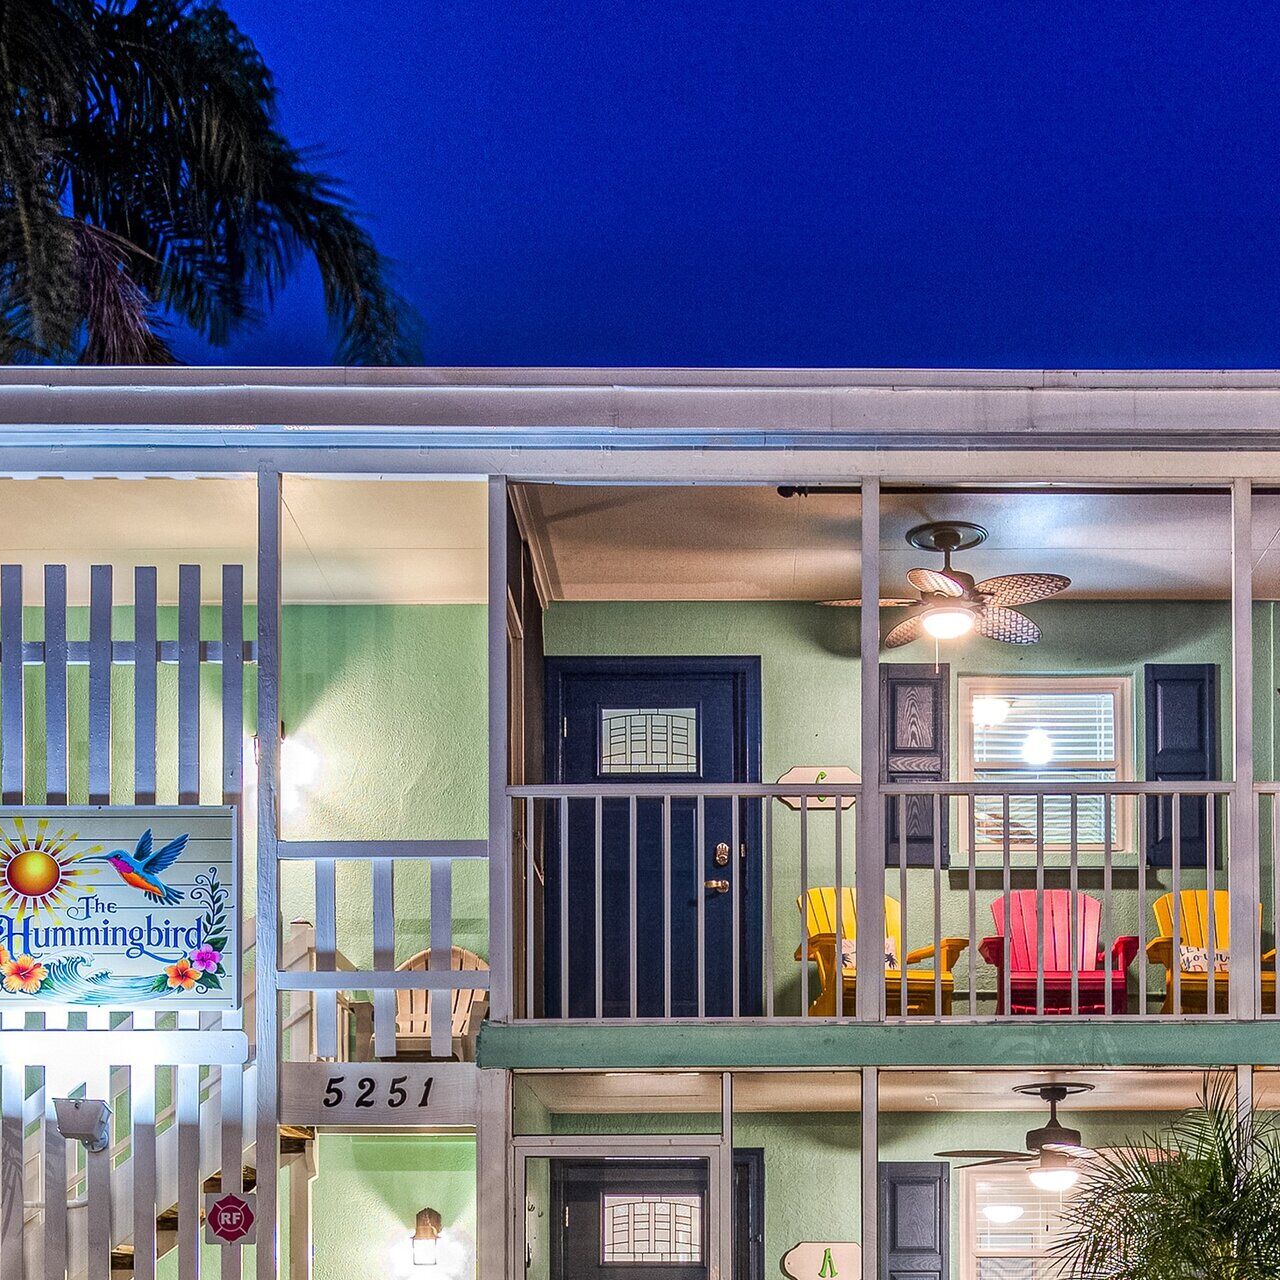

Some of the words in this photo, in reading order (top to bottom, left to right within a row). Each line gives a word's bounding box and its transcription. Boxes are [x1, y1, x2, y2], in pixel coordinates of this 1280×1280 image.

[67, 894, 117, 920] The
[323, 1076, 433, 1107] 5251
[220, 1212, 242, 1225] RF
[818, 1248, 838, 1278] A
